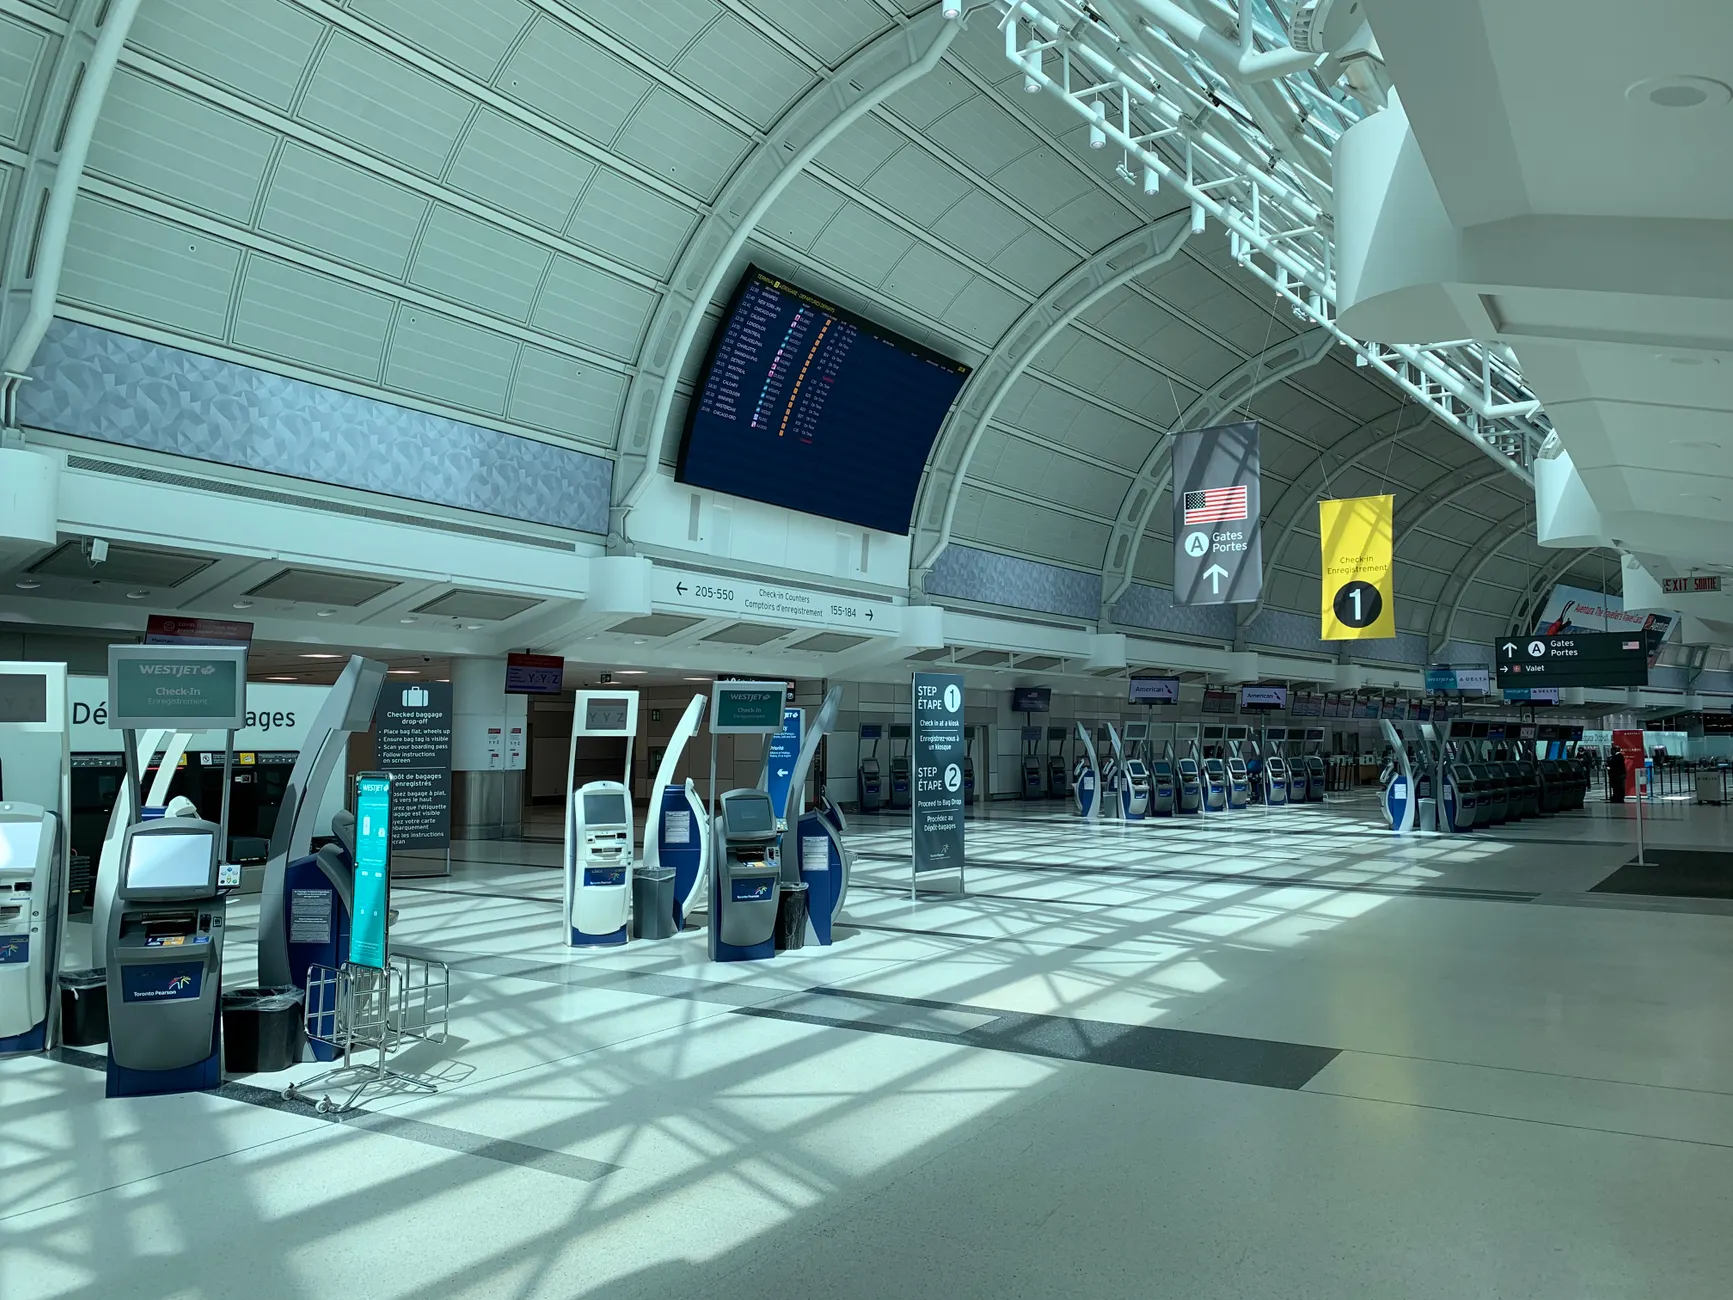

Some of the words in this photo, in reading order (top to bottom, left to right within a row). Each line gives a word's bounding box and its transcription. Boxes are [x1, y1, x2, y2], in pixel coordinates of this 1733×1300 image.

[1191, 536, 1204, 552] A
[1212, 531, 1243, 542] Gates
[1212, 542, 1248, 553] Portes
[1339, 555, 1374, 564] Check-in
[1327, 564, 1388, 575] Enregistrement
[1665, 578, 1688, 592] EXIT
[1694, 577, 1718, 591] SORTIE
[695, 585, 734, 601] 205-550
[758, 588, 784, 600] Check-in
[785, 592, 810, 604] Counters
[744, 599, 775, 611] Comptoirs
[776, 603, 823, 617] d'enregistrement
[1349, 588, 1361, 621] 1
[830, 605, 857, 618] 155-184
[1532, 643, 1542, 654] A
[1551, 649, 1578, 657] Portes
[139, 664, 200, 677] WESTJET
[1525, 664, 1545, 672] Valet
[155, 687, 201, 696] Check-In
[730, 693, 762, 702] WESTJET
[918, 686, 937, 696] STEP
[950, 689, 955, 708] 1
[918, 697, 942, 710] ÉTAPE
[246, 711, 296, 731] ages
[919, 719, 933, 727] Check
[935, 743, 952, 751] kiosque
[918, 767, 937, 778] STEP
[948, 767, 958, 787] 2
[395, 780, 432, 788] enregistrés
[918, 779, 942, 791] ÉTAPE
[942, 799, 951, 807] Bag
[951, 798, 962, 806] Drop
